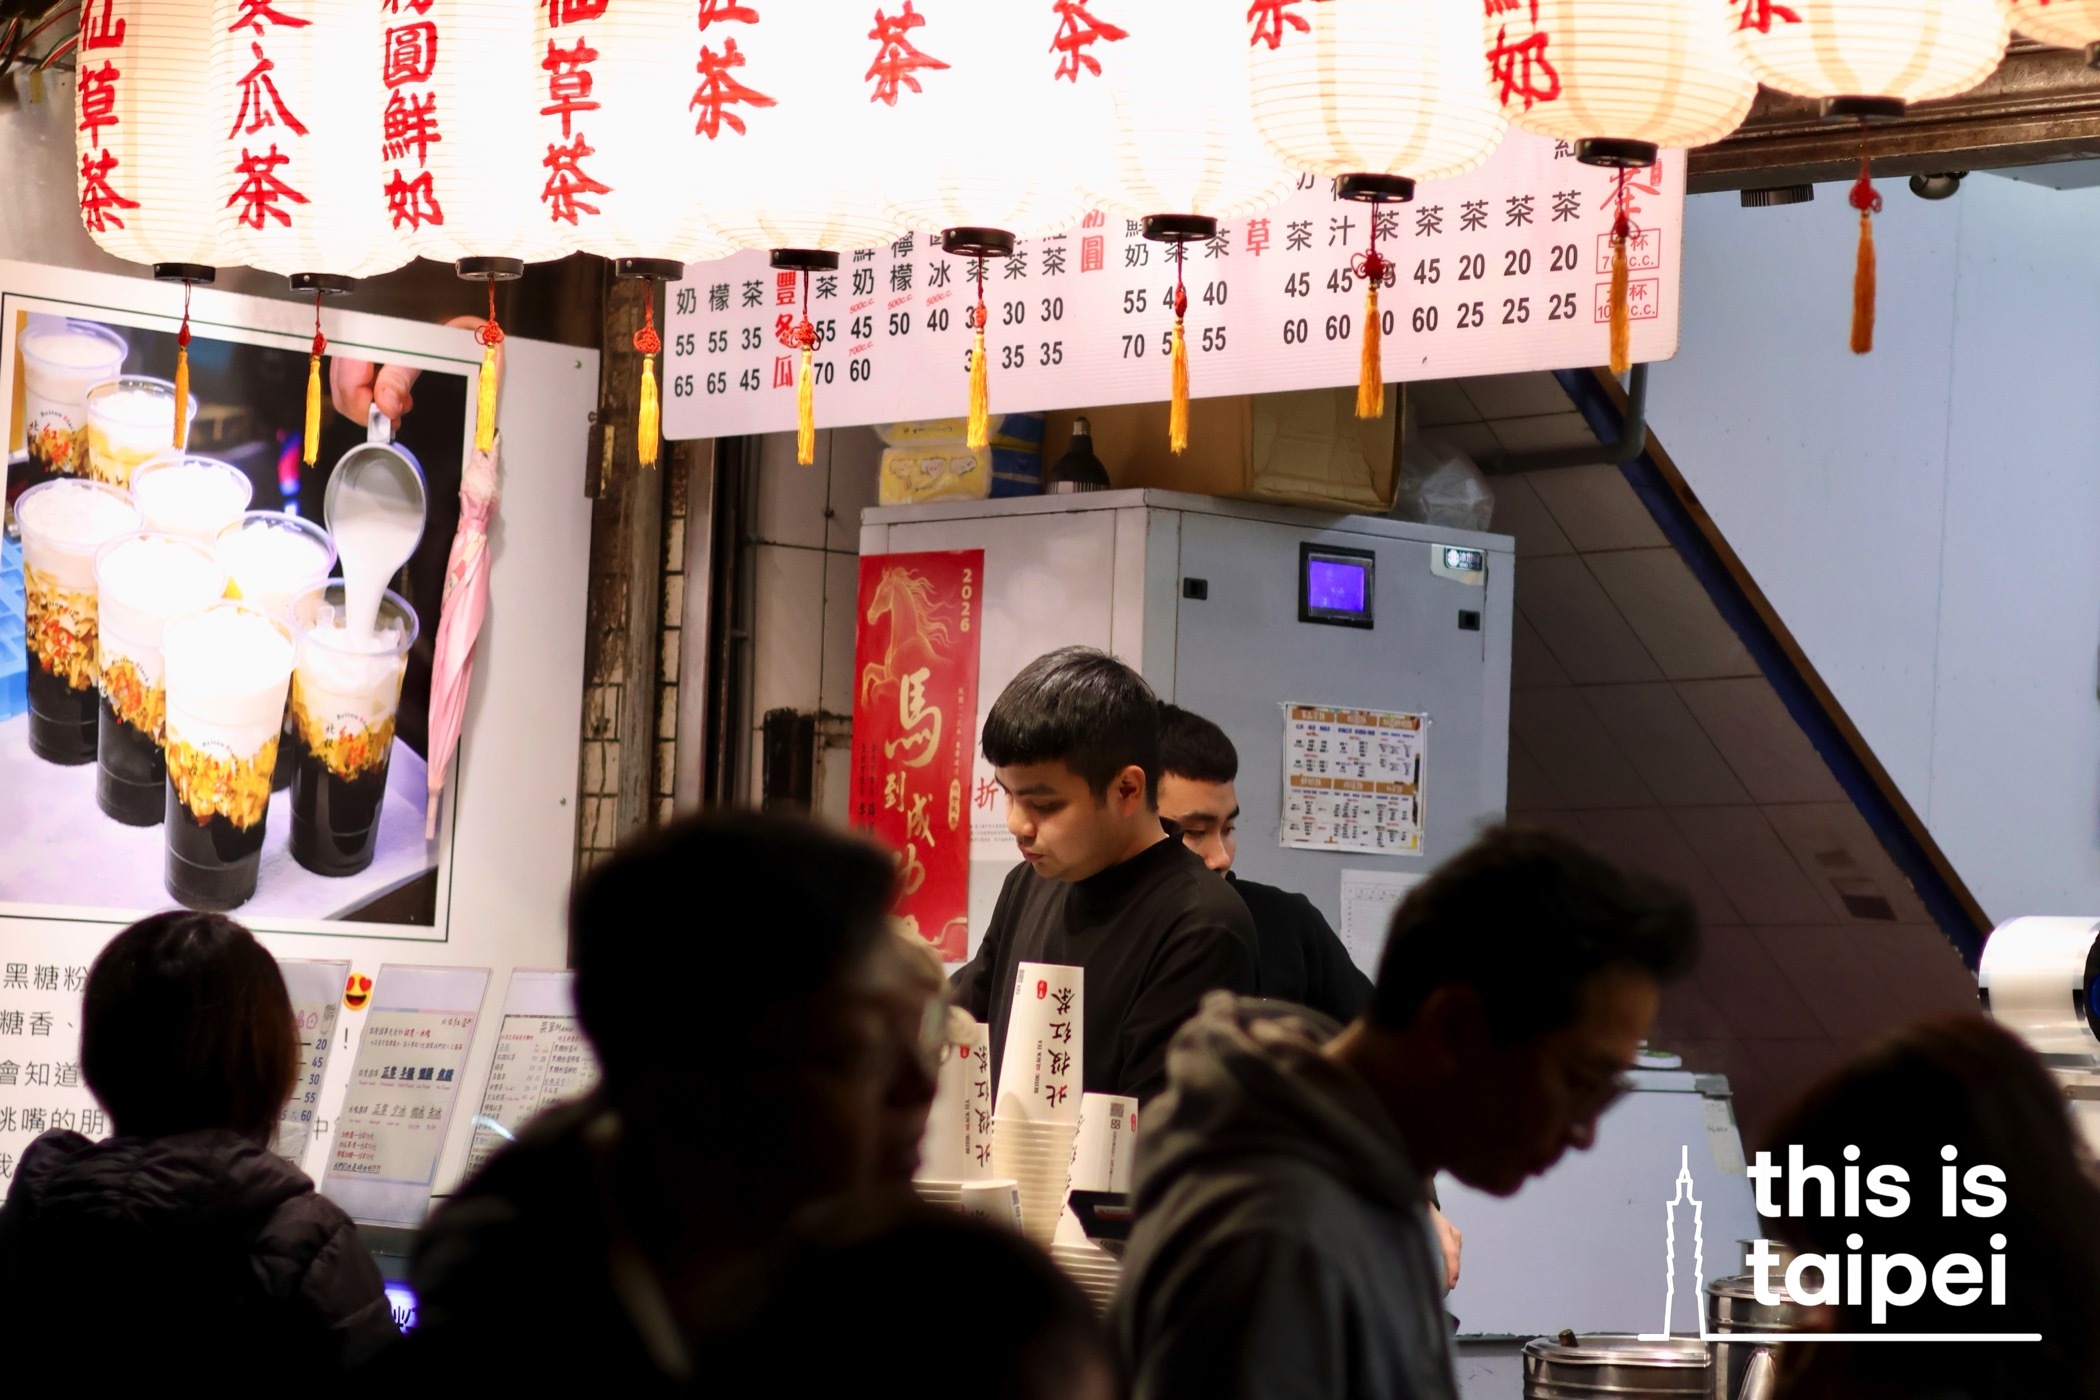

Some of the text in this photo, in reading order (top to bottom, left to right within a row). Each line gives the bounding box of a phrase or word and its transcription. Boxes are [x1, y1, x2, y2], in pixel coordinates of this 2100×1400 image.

[864, 2, 952, 108] 茶
[1048, 0, 1131, 84] 茶
[1483, 0, 1563, 113] 奶
[380, 0, 444, 233] 圓鮮奶
[1416, 205, 1443, 236] 茶
[1460, 200, 1488, 231] 茶
[1506, 195, 1534, 227] 茶
[1552, 190, 1581, 222] 茶
[1245, 218, 1271, 257] 草
[1286, 220, 1313, 251] 茶
[1329, 216, 1355, 246] 汁
[1376, 210, 1400, 242] 茶
[1204, 228, 1231, 259] 茶
[966, 258, 992, 283] 茶
[1004, 250, 1029, 280] 茶
[1042, 247, 1066, 275] 茶
[1285, 272, 1309, 297] 45
[1327, 265, 1353, 293] 45
[1414, 258, 1440, 284] 45
[1458, 254, 1485, 280] 20
[1504, 249, 1531, 276] 20
[1550, 244, 1577, 271] 20
[677, 288, 696, 314] 奶
[743, 280, 763, 307] 茶
[816, 276, 837, 299] 茶
[1124, 289, 1146, 314] 55
[1203, 281, 1227, 305] 40
[815, 319, 837, 343] 55
[851, 316, 872, 339] 45
[889, 312, 909, 336] 50
[927, 309, 948, 331] 40
[1003, 301, 1024, 325] 30
[1041, 297, 1063, 321] 30
[1284, 319, 1308, 344] 60
[1326, 315, 1350, 340] 60
[1413, 306, 1438, 332] 60
[1457, 302, 1483, 328] 25
[1502, 297, 1529, 324] 25
[1549, 293, 1576, 320] 25
[676, 327, 761, 356] 55 55 35
[1122, 334, 1144, 358] 70
[1202, 327, 1226, 352] 55
[814, 362, 834, 384] 70
[850, 359, 870, 382] 60
[1002, 345, 1024, 369] 35
[1040, 341, 1062, 366] 35
[675, 369, 760, 397] 65 65 45
[959, 567, 973, 633] 2026
[974, 777, 999, 812] 折
[315, 1038, 328, 1050] 20
[312, 1056, 324, 1068] 45
[308, 1074, 320, 1085] 30
[304, 1092, 316, 1103] 55
[300, 1110, 312, 1121] 60
